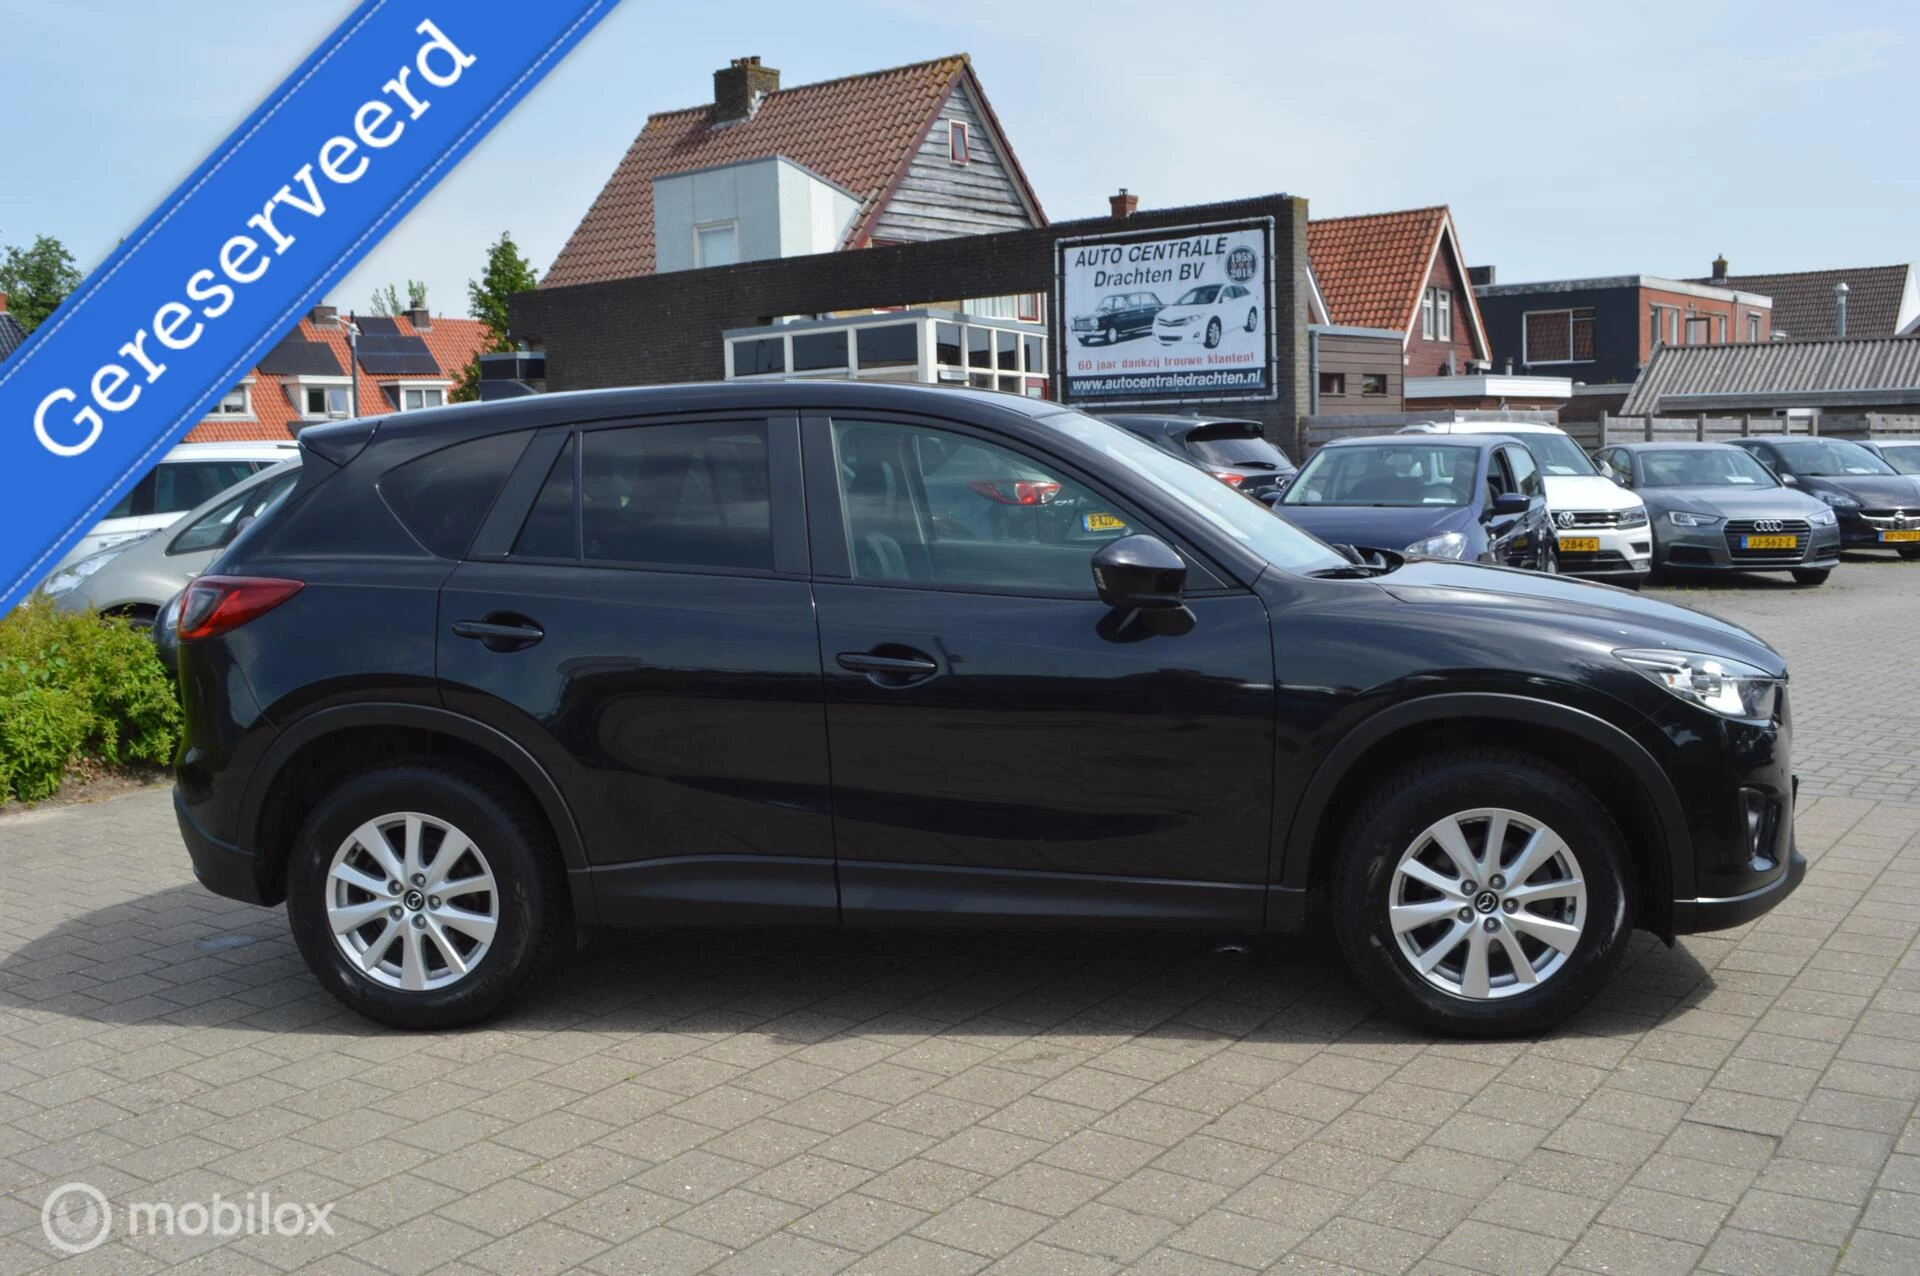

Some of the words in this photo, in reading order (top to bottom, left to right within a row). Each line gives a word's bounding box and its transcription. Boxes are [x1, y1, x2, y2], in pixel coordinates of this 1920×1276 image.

[1075, 248, 1123, 267] AUTO
[1128, 237, 1228, 262] CENTRALE
[1231, 252, 1253, 263] 1958
[1094, 267, 1173, 287] Drachten
[1179, 262, 1205, 281] BV
[1230, 267, 1254, 279] 2018
[1078, 360, 1092, 370] 60
[1097, 360, 1117, 371] jaar
[1121, 358, 1160, 370] dankzij
[1164, 356, 1203, 367] trouwe
[1207, 353, 1255, 364] klanten!
[1072, 369, 1261, 391] www.autocentraledrachten.nl
